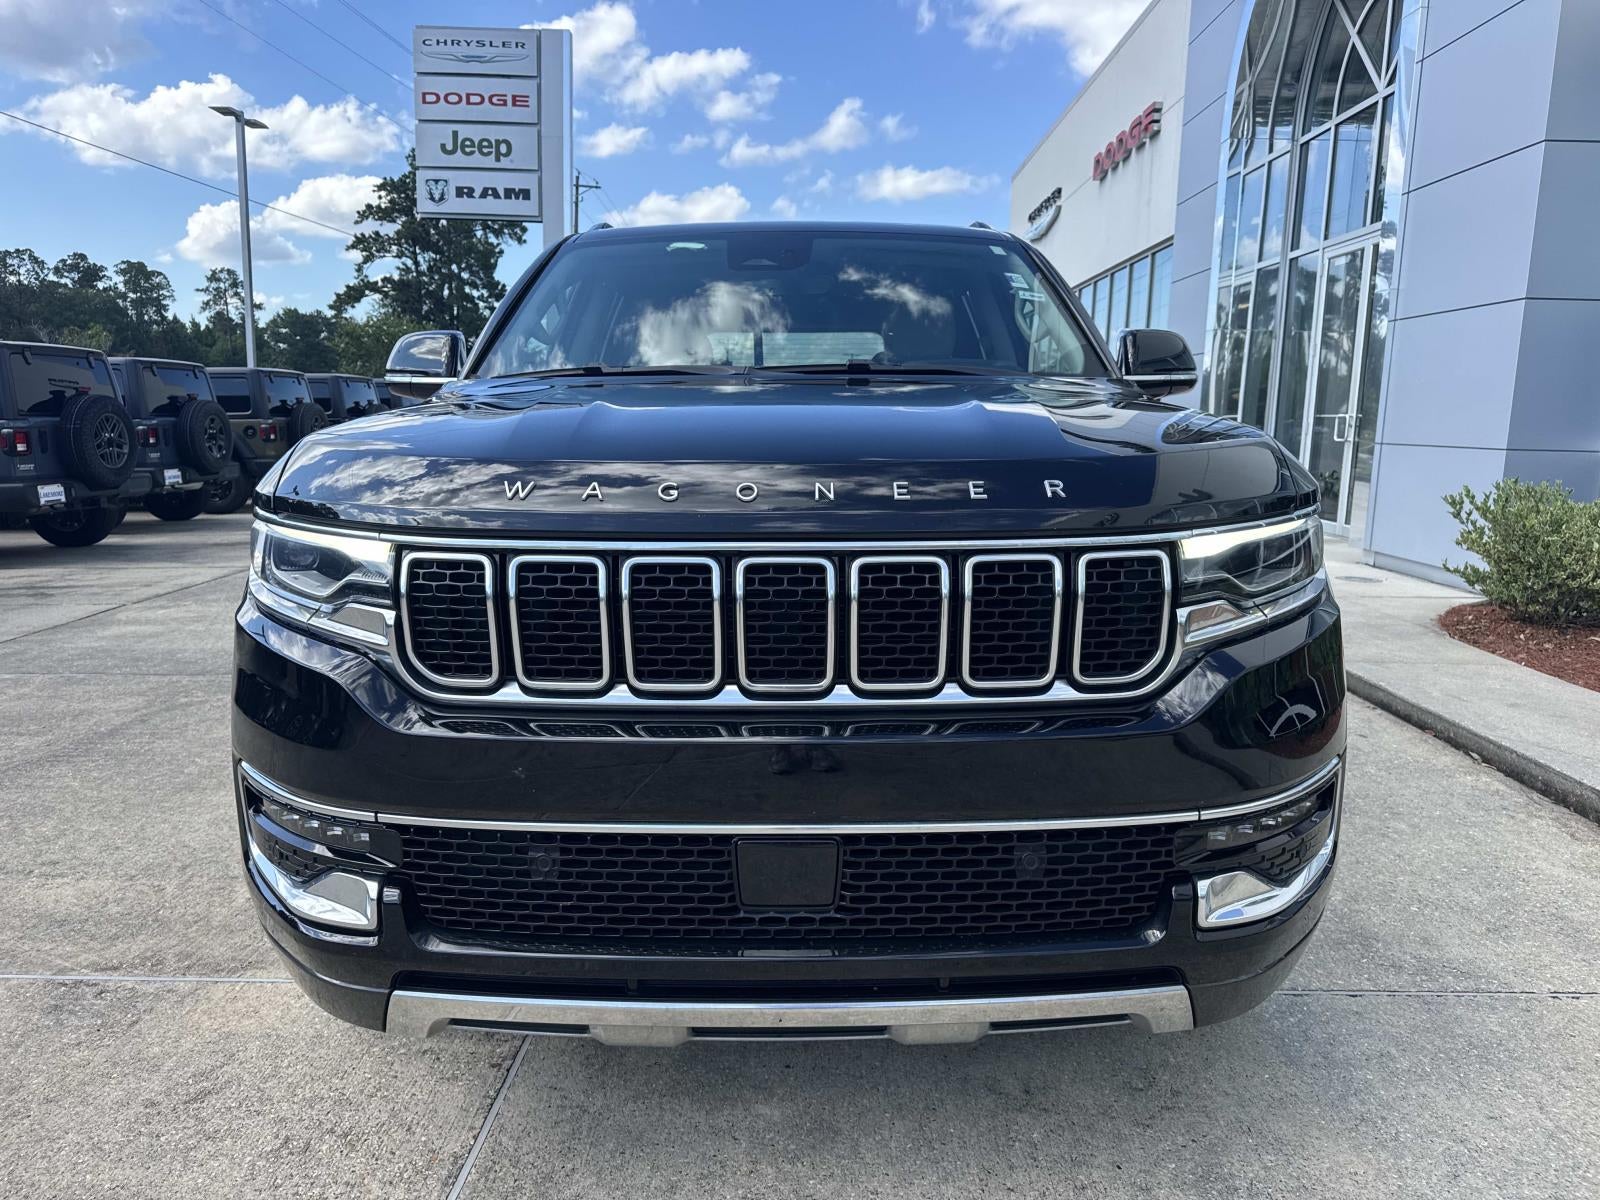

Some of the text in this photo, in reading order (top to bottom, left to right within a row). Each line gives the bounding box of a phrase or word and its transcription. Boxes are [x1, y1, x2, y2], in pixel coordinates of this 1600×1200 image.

[422, 38, 527, 50] CHRYSLER
[421, 91, 530, 109] DODGE
[440, 130, 513, 163] Jeep
[1092, 101, 1163, 182] DODGE
[455, 186, 531, 201] RAM
[503, 479, 1066, 501] WAGONEER
